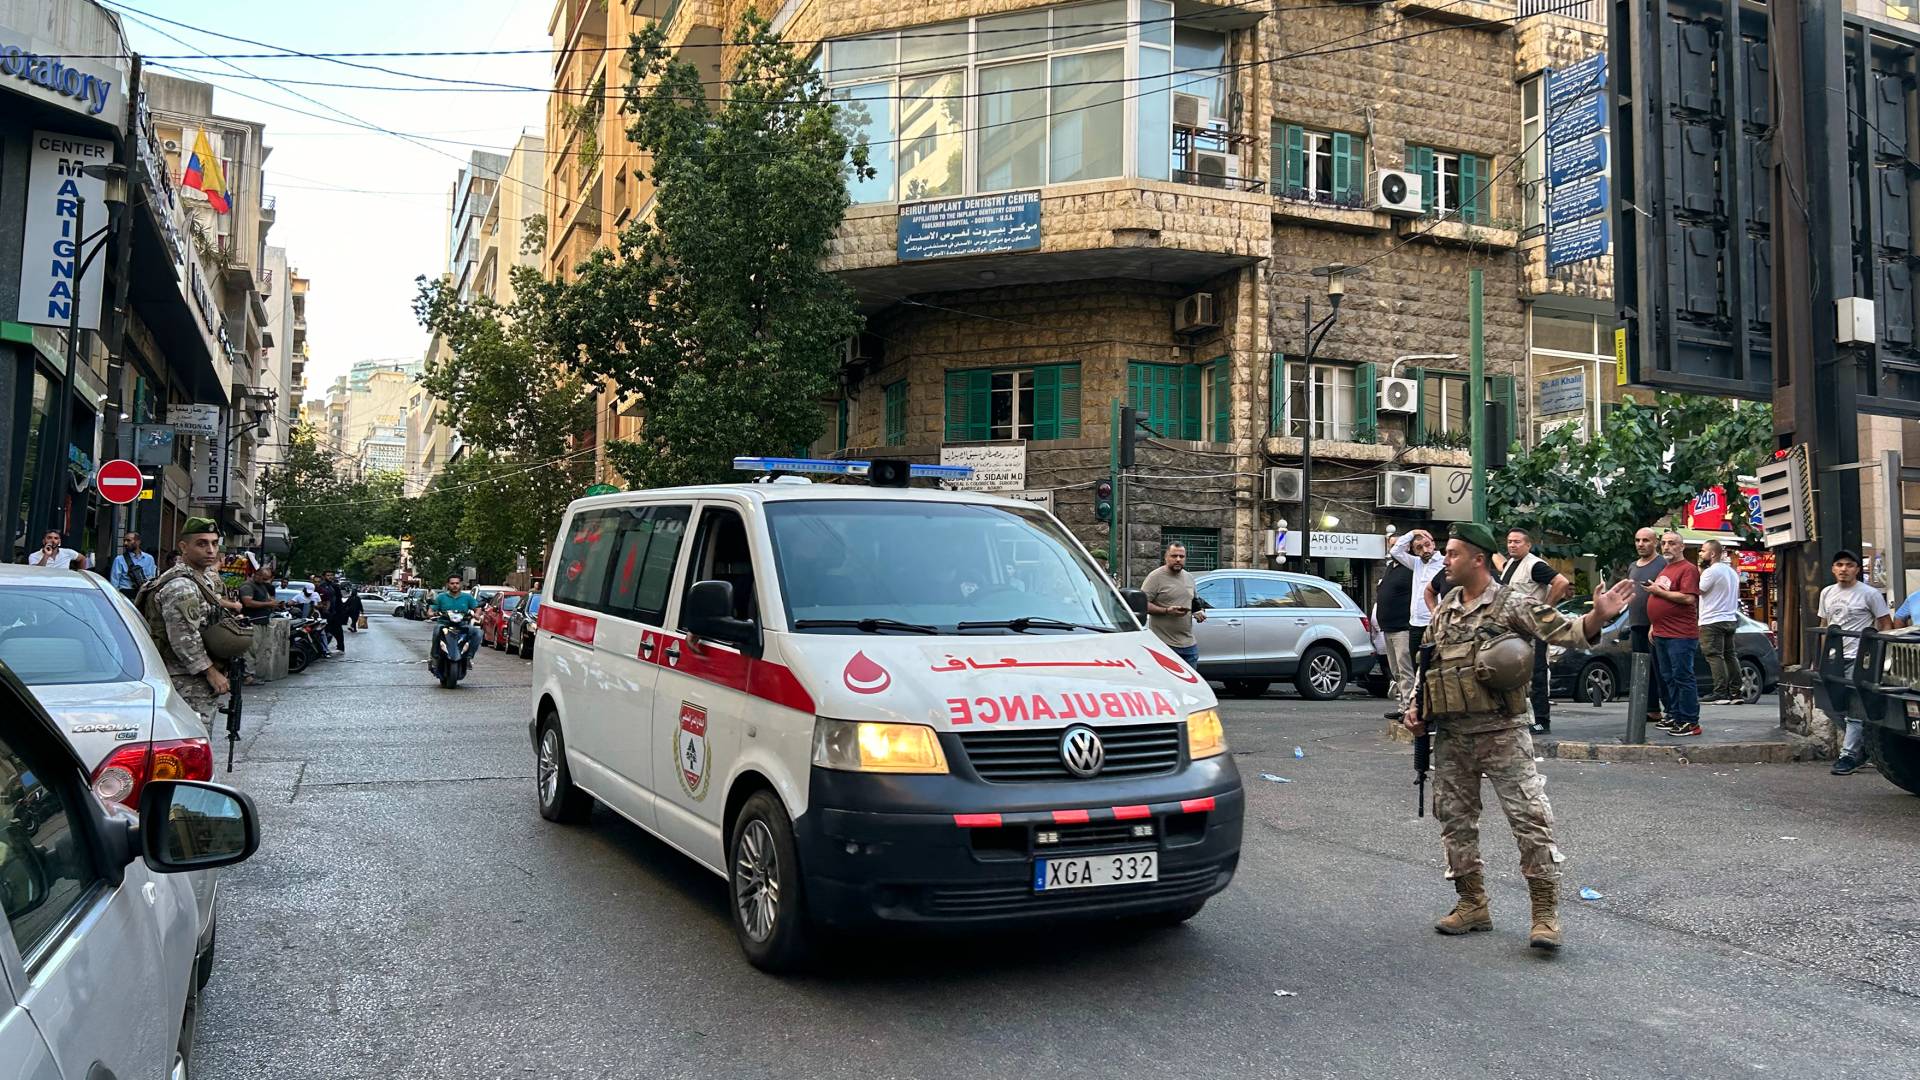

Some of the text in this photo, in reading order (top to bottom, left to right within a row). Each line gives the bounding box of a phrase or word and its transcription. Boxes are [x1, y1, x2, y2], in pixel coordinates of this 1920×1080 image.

[0, 43, 112, 114] oratory
[39, 138, 104, 158] CENTER
[900, 192, 1038, 216] BEIRUT IMPLANT DENTISTRY CENTRE
[912, 214, 938, 223] AFFILIATED
[979, 208, 1004, 216] DENTISTRY
[922, 222, 946, 230] FAULKNER
[946, 220, 968, 228] HOSPITAL
[972, 226, 1006, 238] بيروت
[1009, 222, 1038, 234] مركز
[48, 158, 84, 320] MARIGNAN
[1561, 373, 1582, 385] Khalil
[208, 438, 218, 494] EEKEND
[930, 654, 1143, 676] إسعاف
[72, 723, 140, 733] COROLLA
[1050, 856, 1152, 886] XGA 332
